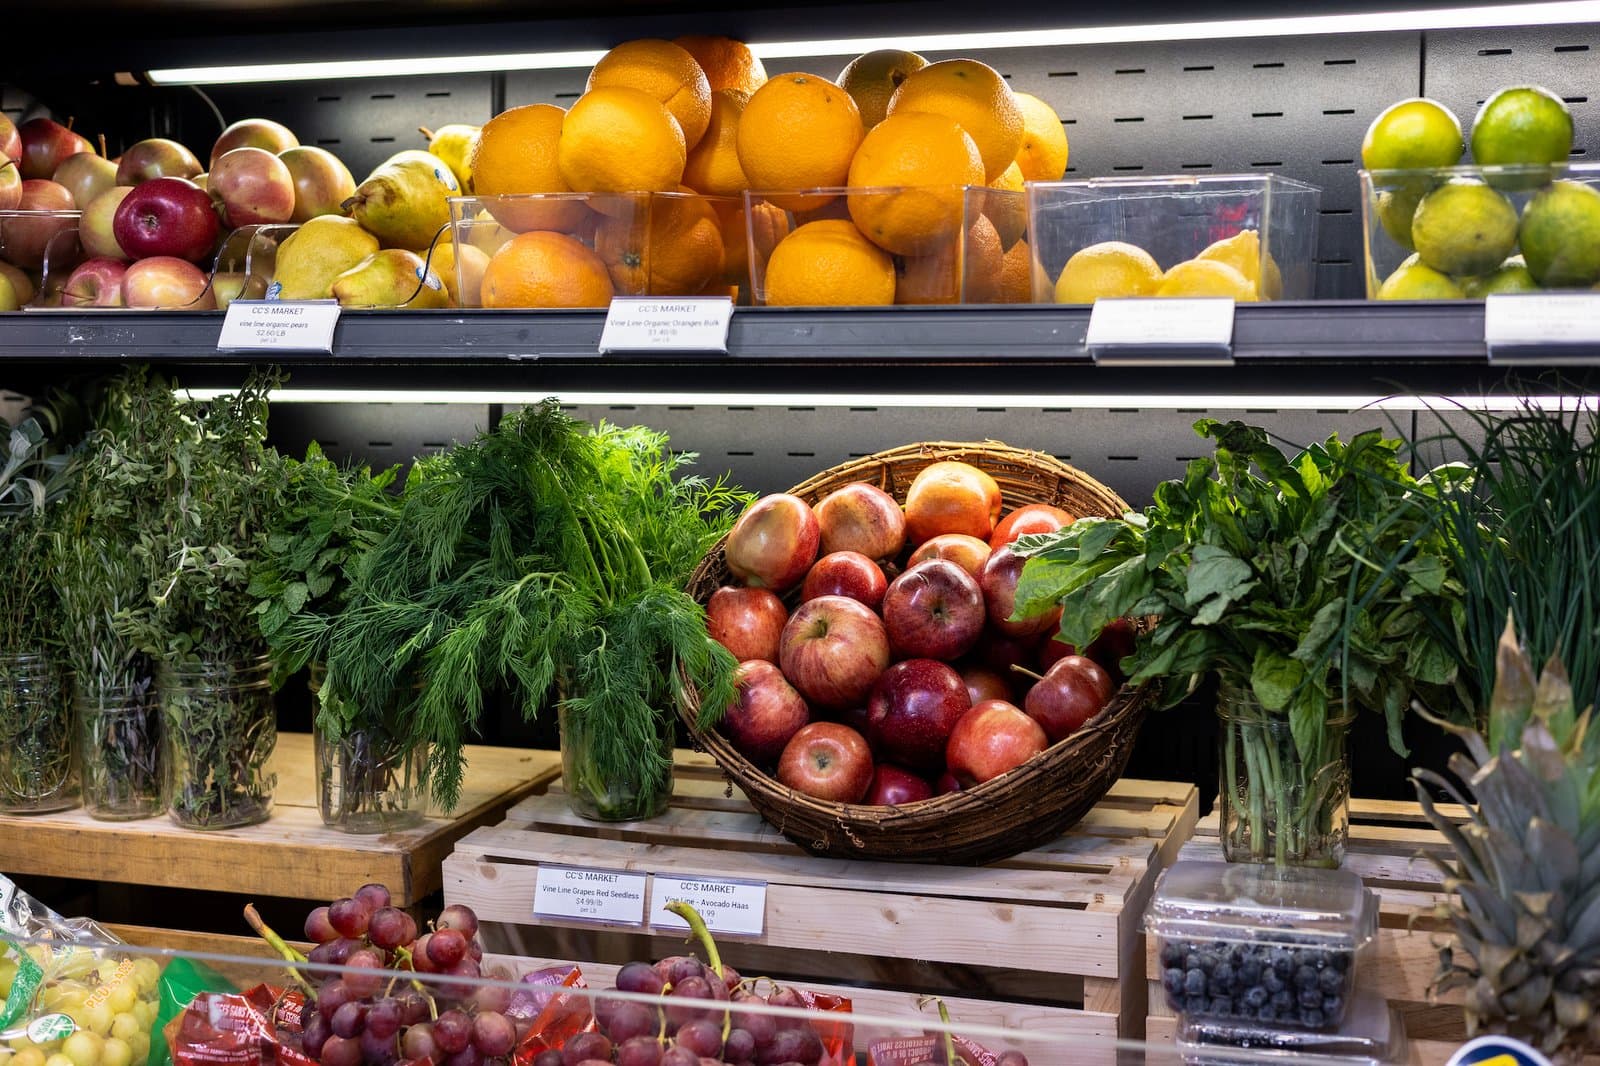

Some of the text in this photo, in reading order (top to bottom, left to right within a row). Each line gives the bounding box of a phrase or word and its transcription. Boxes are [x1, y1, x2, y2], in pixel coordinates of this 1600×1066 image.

[271, 307, 305, 315] MARKET
[660, 305, 697, 313] MARKET
[266, 321, 289, 329] organic
[290, 321, 308, 330] pears
[565, 871, 619, 884] CC'S MARKET
[542, 884, 640, 900] Vine Line Grapes Red Seedless
[680, 881, 736, 895] CC'S MARKET
[701, 898, 731, 909] Avocado
[731, 901, 749, 910] Haas
